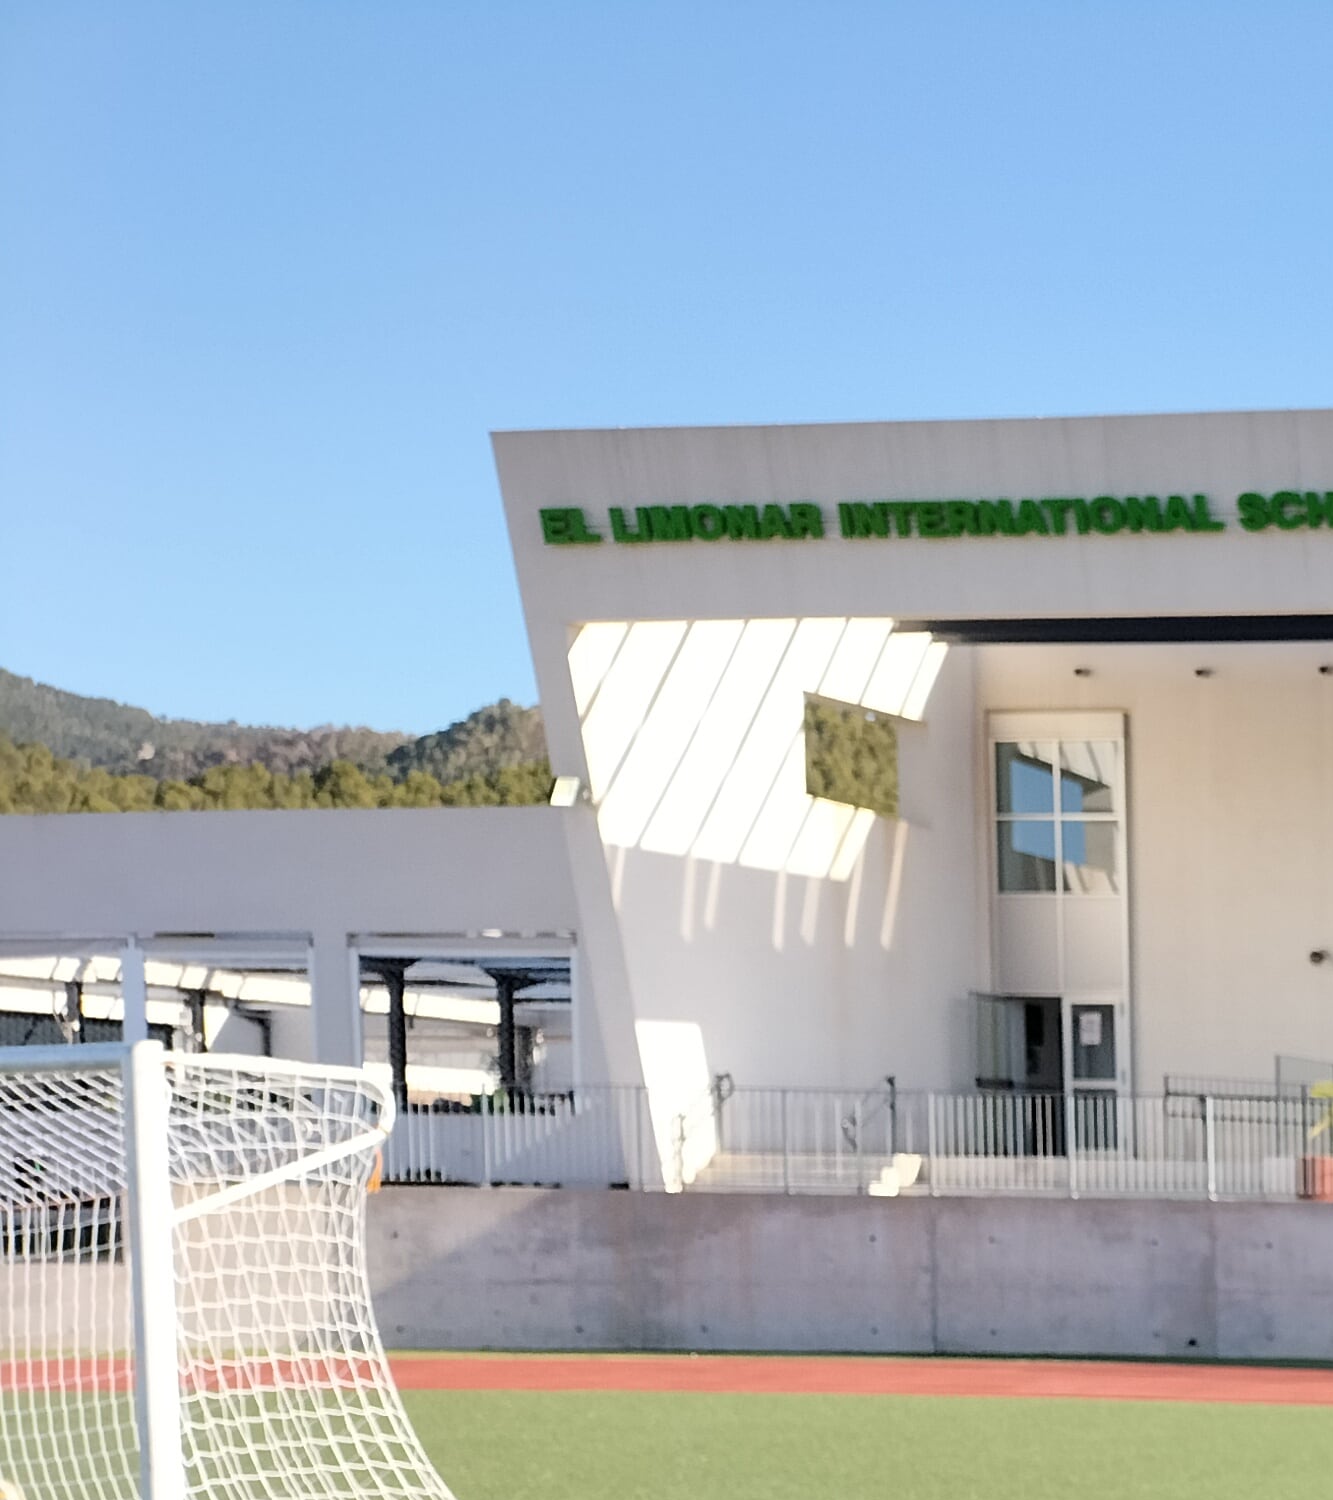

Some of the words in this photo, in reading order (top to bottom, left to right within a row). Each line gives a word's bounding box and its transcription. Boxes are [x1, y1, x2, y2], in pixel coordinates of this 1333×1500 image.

[540, 508, 603, 544] EL
[608, 504, 825, 542] LIMONAR
[838, 495, 1224, 538] INTERNATIONAL
